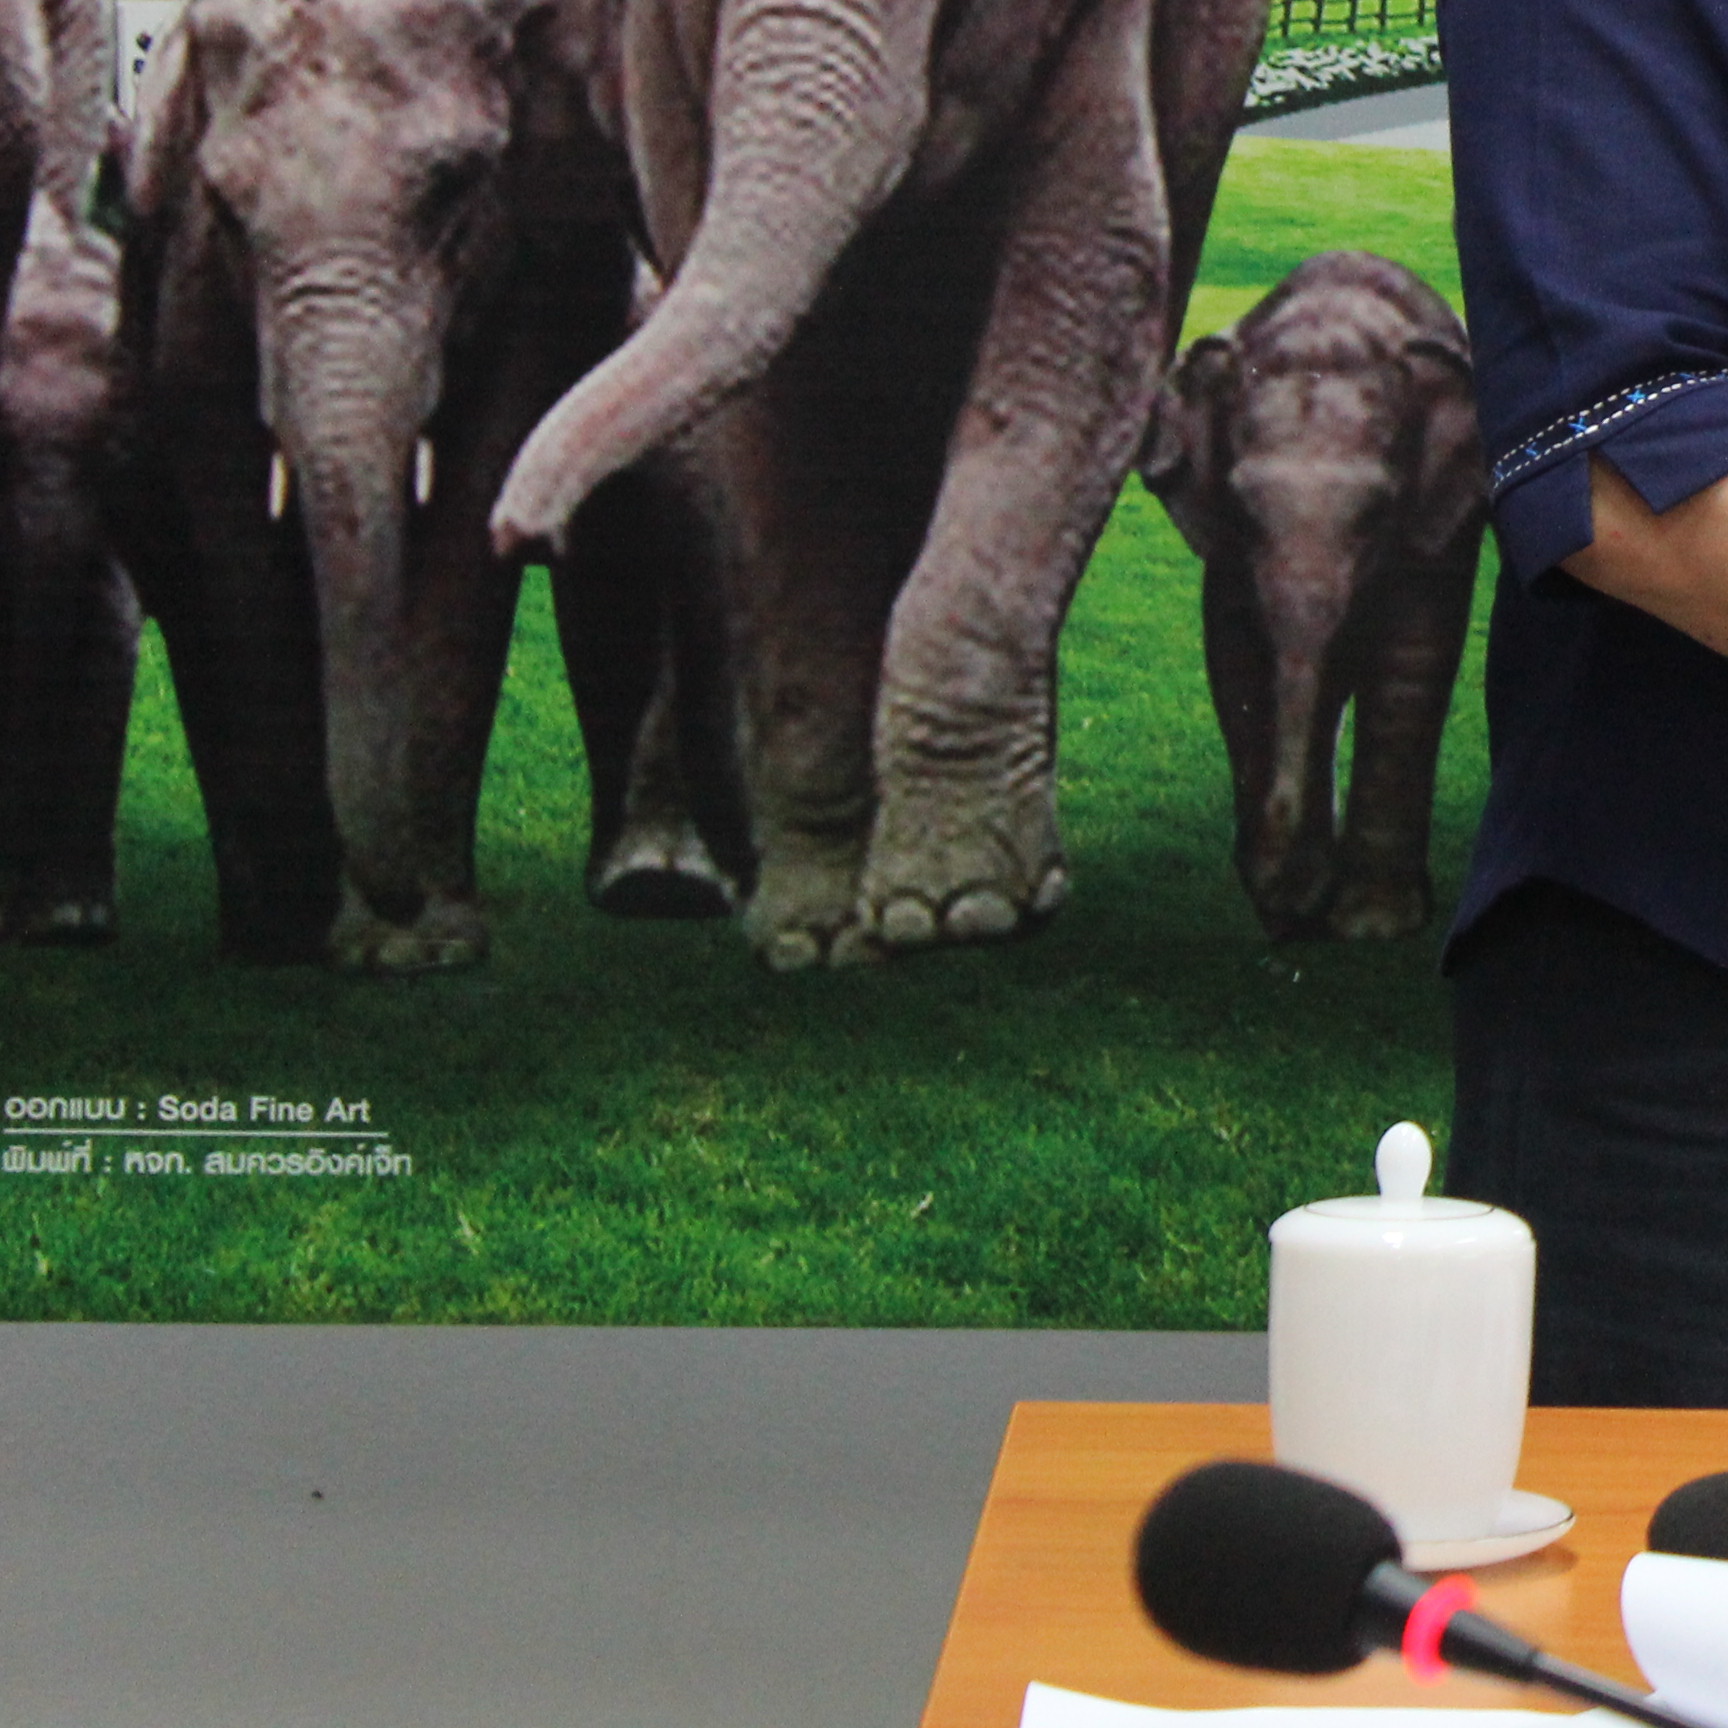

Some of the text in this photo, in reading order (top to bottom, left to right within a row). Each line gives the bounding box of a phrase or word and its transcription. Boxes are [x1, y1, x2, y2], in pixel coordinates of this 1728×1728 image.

[4, 1097, 125, 1120] ออกแบบ
[158, 1094, 238, 1122] Soda
[249, 1096, 314, 1122] Fine
[324, 1097, 371, 1123] Art
[2, 1139, 93, 1173] พิมพ์ที่
[124, 1151, 192, 1174] หจก.
